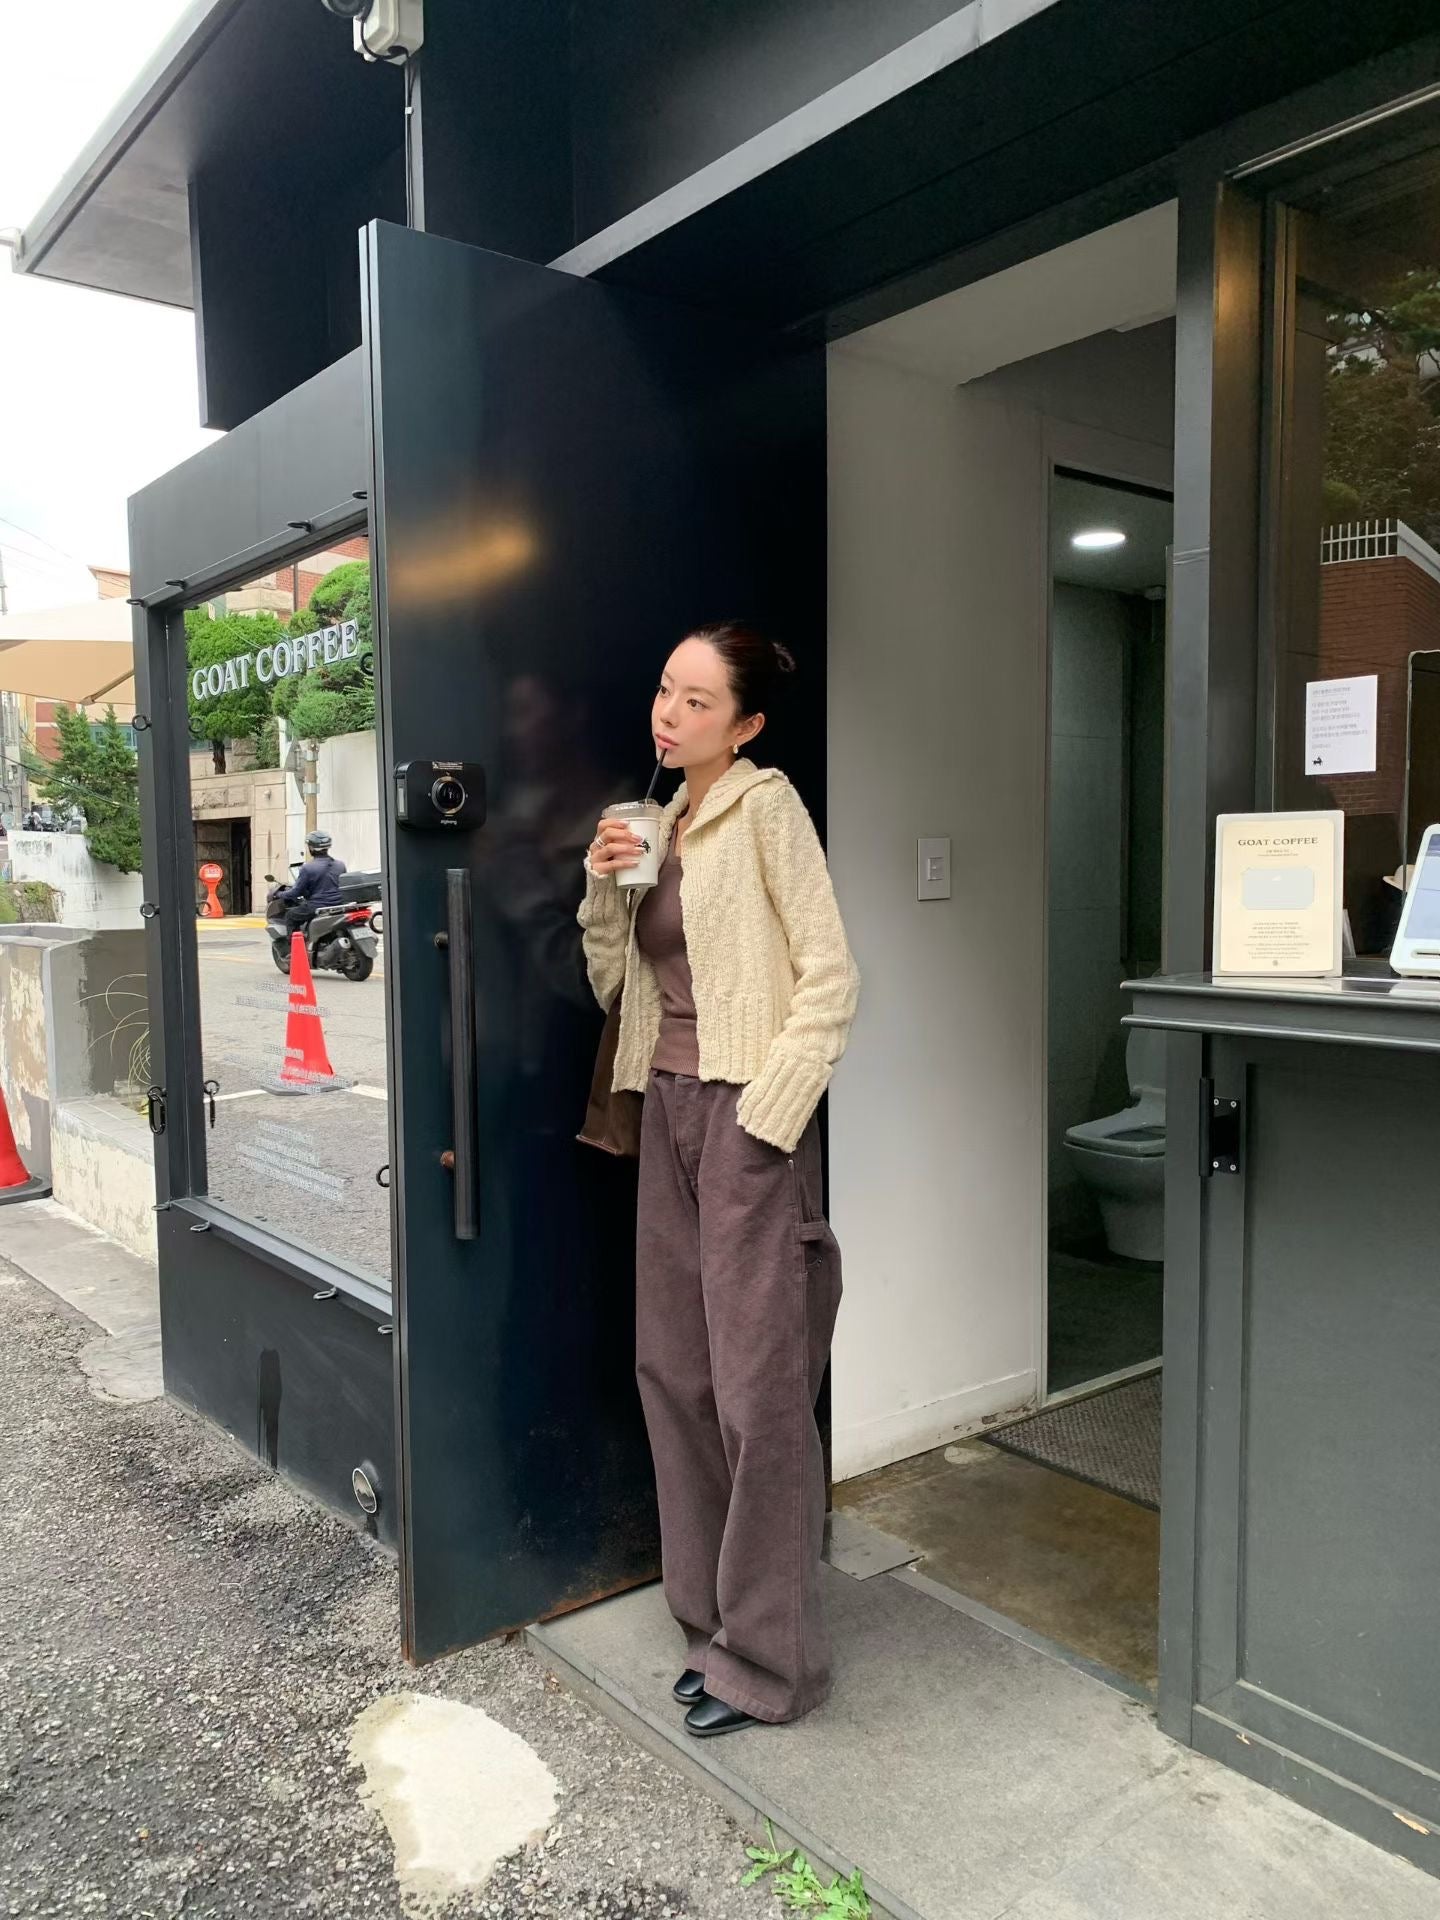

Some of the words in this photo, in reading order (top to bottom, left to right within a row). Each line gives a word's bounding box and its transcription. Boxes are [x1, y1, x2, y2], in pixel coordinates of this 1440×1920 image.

[192, 652, 251, 701] GOAT
[256, 618, 360, 684] COFFEE
[1272, 837, 1318, 846] COFFEE
